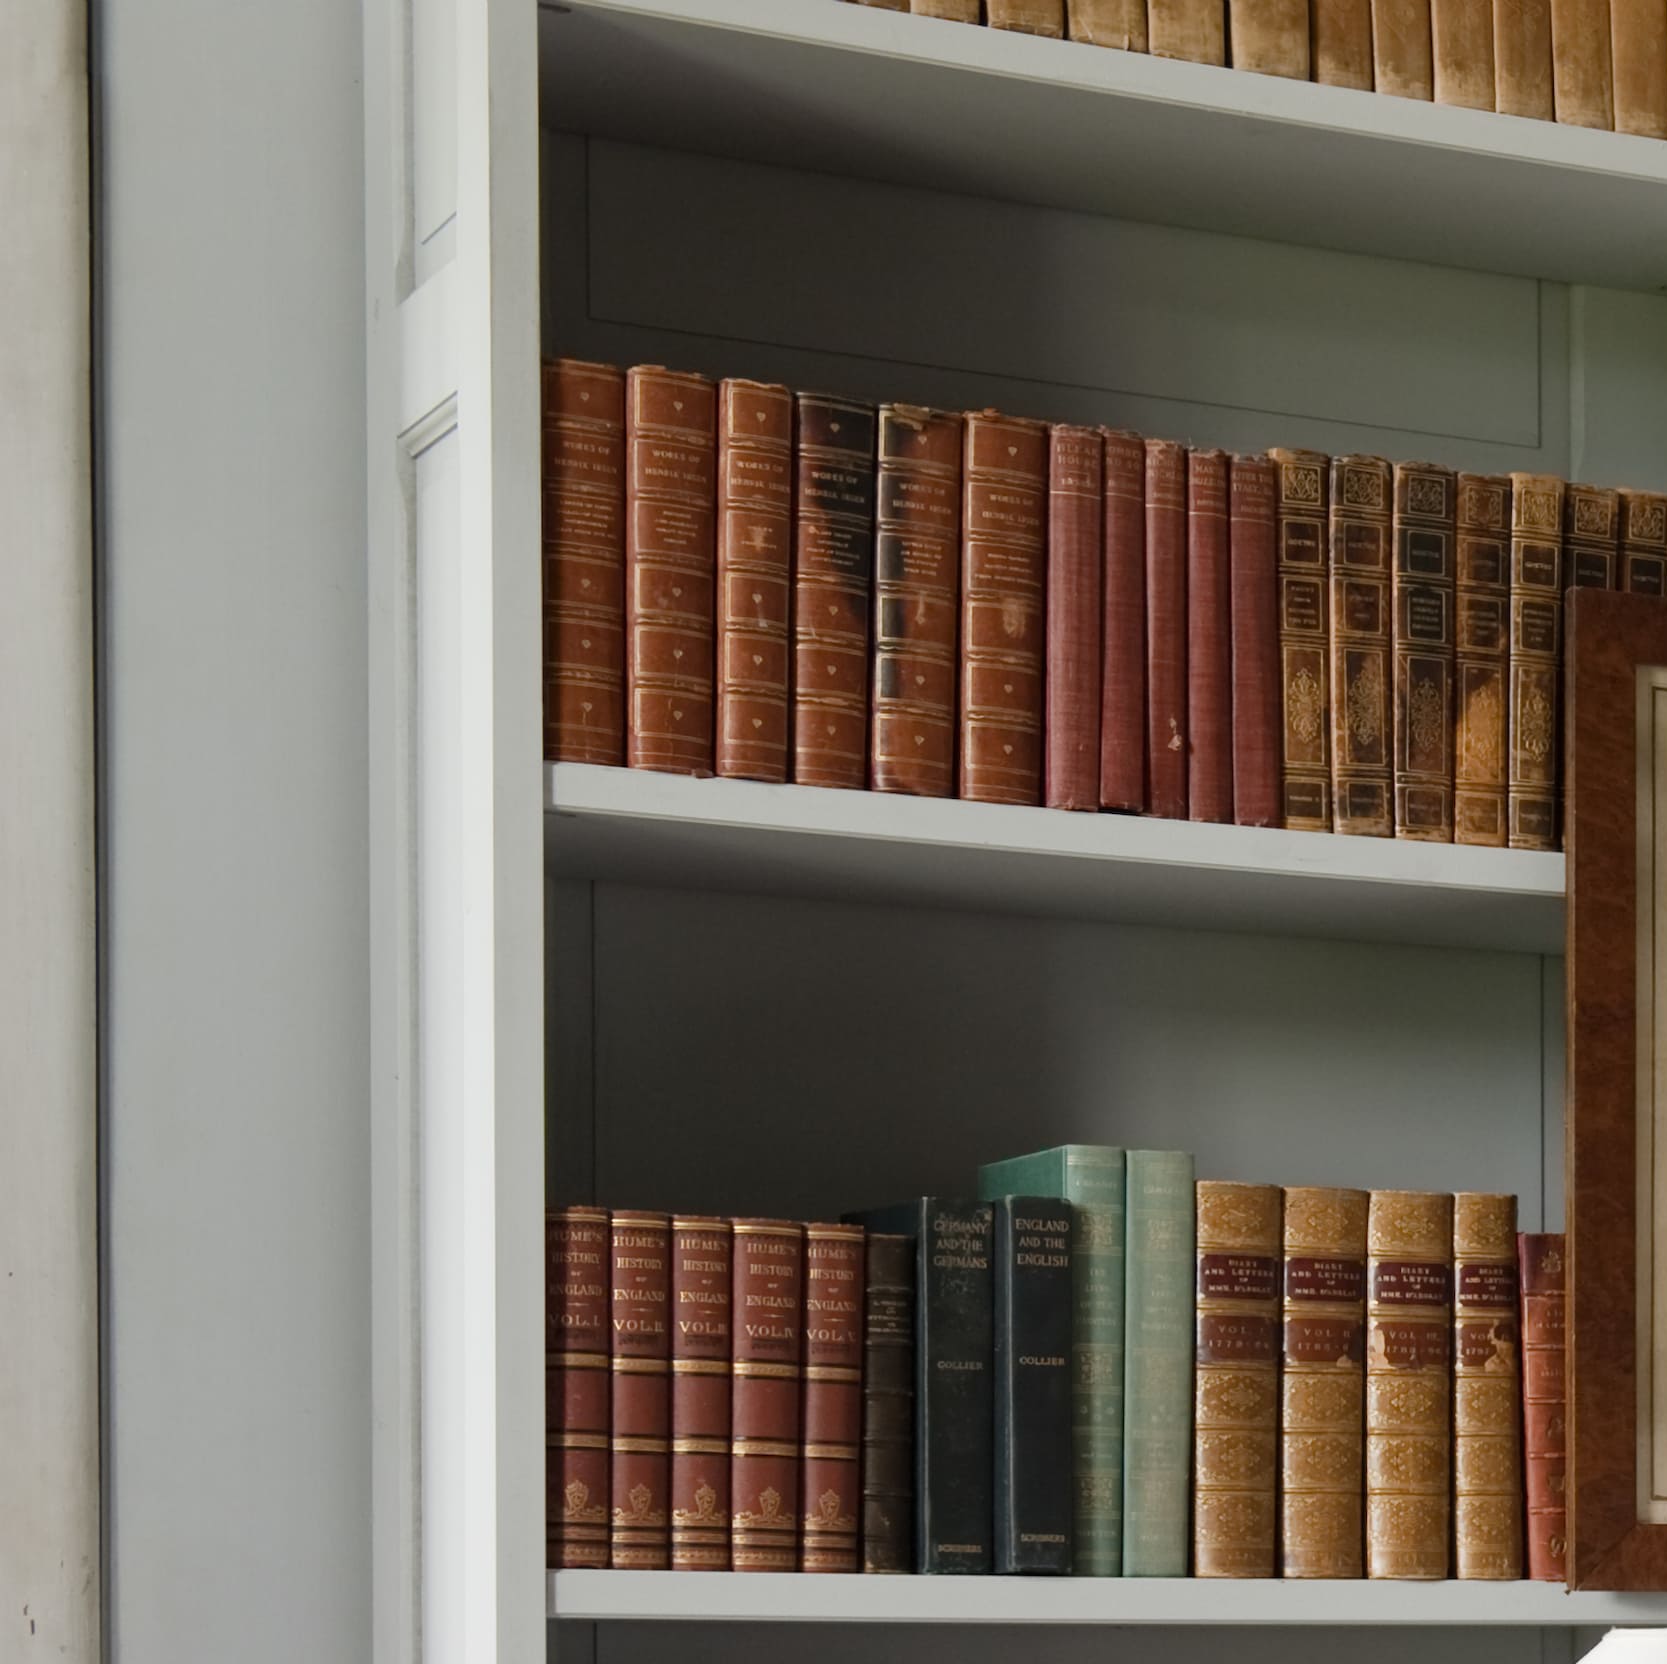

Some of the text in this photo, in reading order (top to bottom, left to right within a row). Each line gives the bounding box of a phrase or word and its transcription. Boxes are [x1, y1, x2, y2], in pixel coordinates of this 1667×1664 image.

[934, 1220, 988, 1235] GERMANY
[1015, 1218, 1070, 1232] ENGLAND
[550, 1231, 603, 1242] HUME'S
[612, 1235, 665, 1248] HUME'S
[1019, 1236, 1066, 1249] AND THE
[680, 1238, 728, 1250] HUME'S
[747, 1242, 797, 1256] HUME'S
[936, 1238, 983, 1252] AND THE
[552, 1252, 600, 1264] HISTORY
[616, 1257, 662, 1269] HISTORY
[933, 1256, 988, 1269] GERMANS
[1017, 1253, 1069, 1267] ENGLISH
[682, 1259, 727, 1272] HISTORY
[750, 1263, 793, 1277] HISTORY
[809, 1268, 854, 1280] HISTORY
[550, 1284, 602, 1296] ENGLAND
[613, 1289, 665, 1302] ENGLAND
[679, 1291, 728, 1304] ENGLAND
[745, 1294, 795, 1308] ENGLAND
[807, 1299, 856, 1312] ENGLAND
[936, 1361, 984, 1371] COLLIER
[1019, 1356, 1066, 1366] COLLIER
